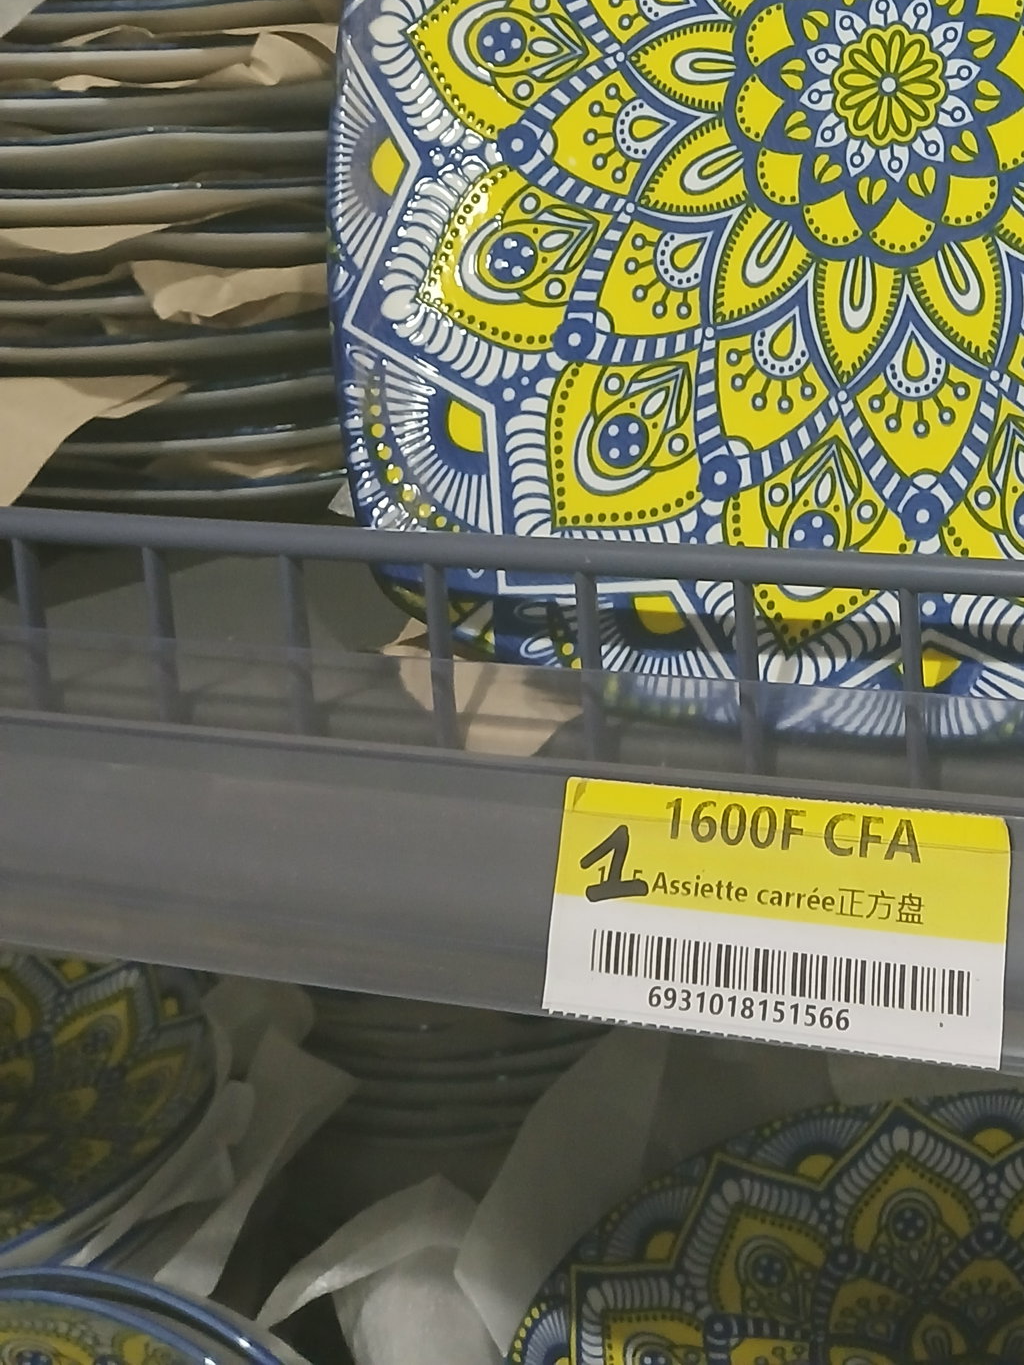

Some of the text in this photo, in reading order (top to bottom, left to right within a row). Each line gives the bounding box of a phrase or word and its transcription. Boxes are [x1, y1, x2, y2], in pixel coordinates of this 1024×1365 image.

[666, 797, 921, 864] 1600F CFA
[580, 824, 649, 903] 1
[651, 871, 748, 903] Assiette
[648, 985, 850, 1031] 6931018151566
